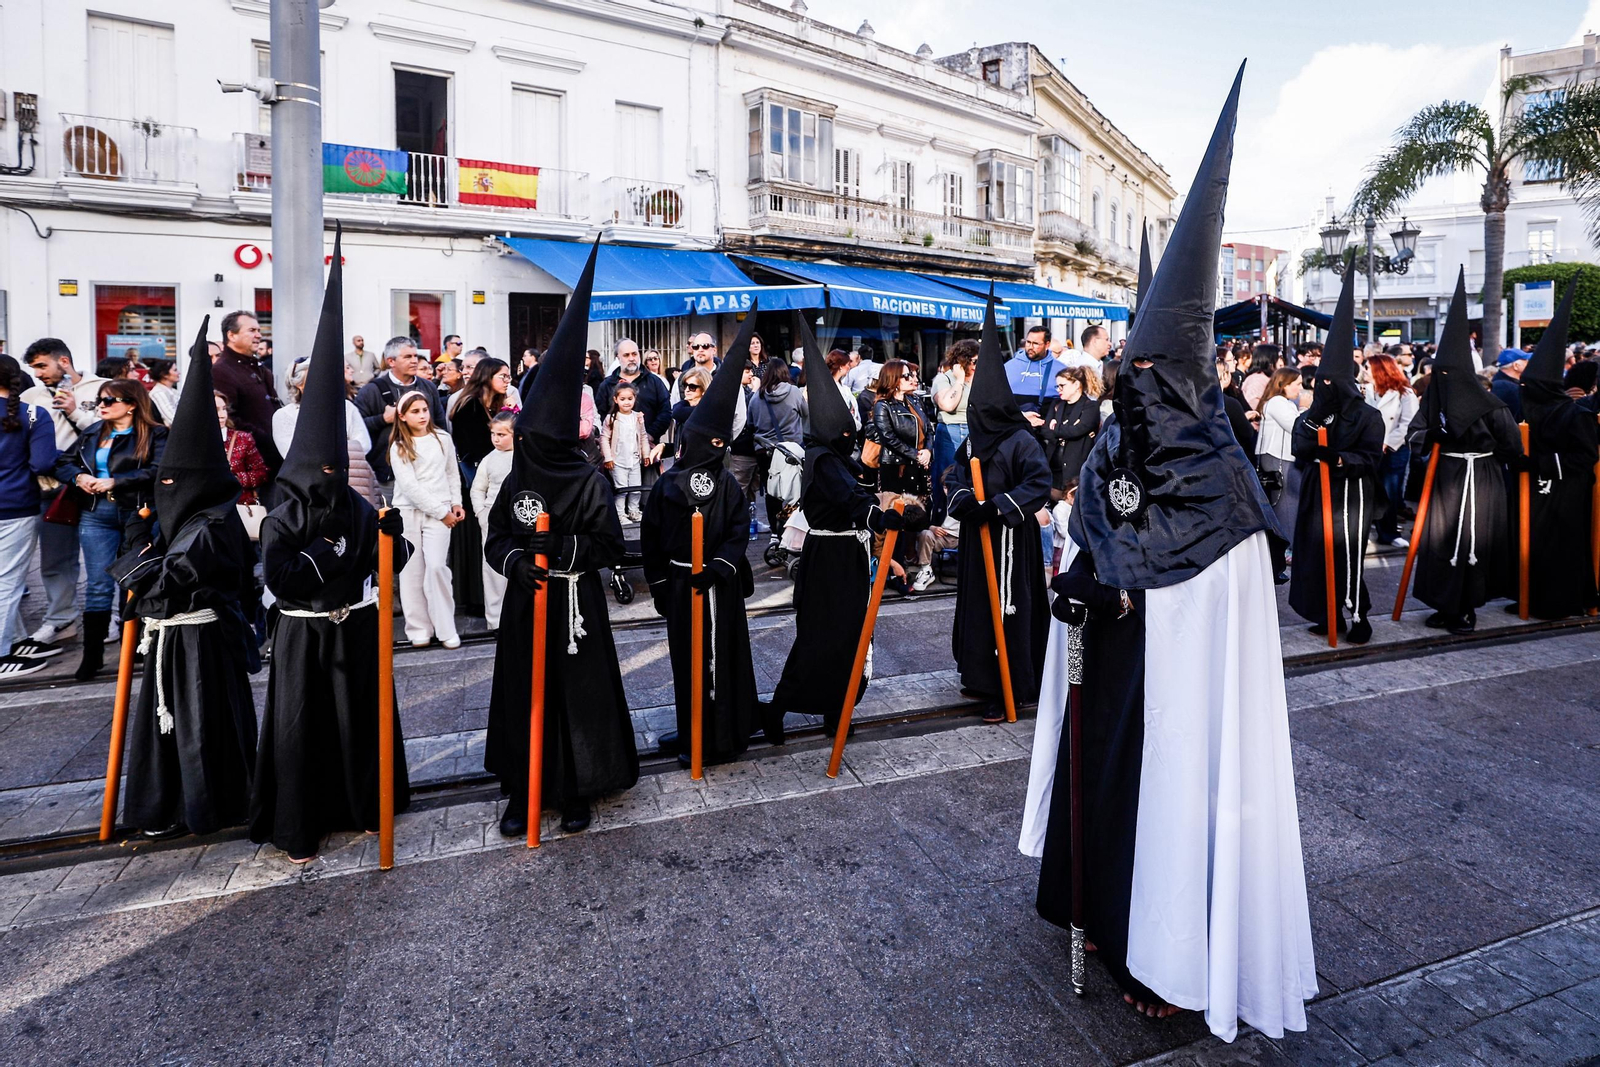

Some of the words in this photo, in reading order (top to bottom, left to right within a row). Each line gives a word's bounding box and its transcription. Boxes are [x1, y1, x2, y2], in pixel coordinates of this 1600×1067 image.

[592, 301, 625, 311] Mahou
[684, 294, 750, 310] TAPAS
[873, 297, 936, 315] RACIONES
[940, 304, 948, 317] Y
[952, 306, 983, 320] MENÚ
[1033, 306, 1044, 316] LA
[1047, 306, 1105, 317] MALLORQUINA
